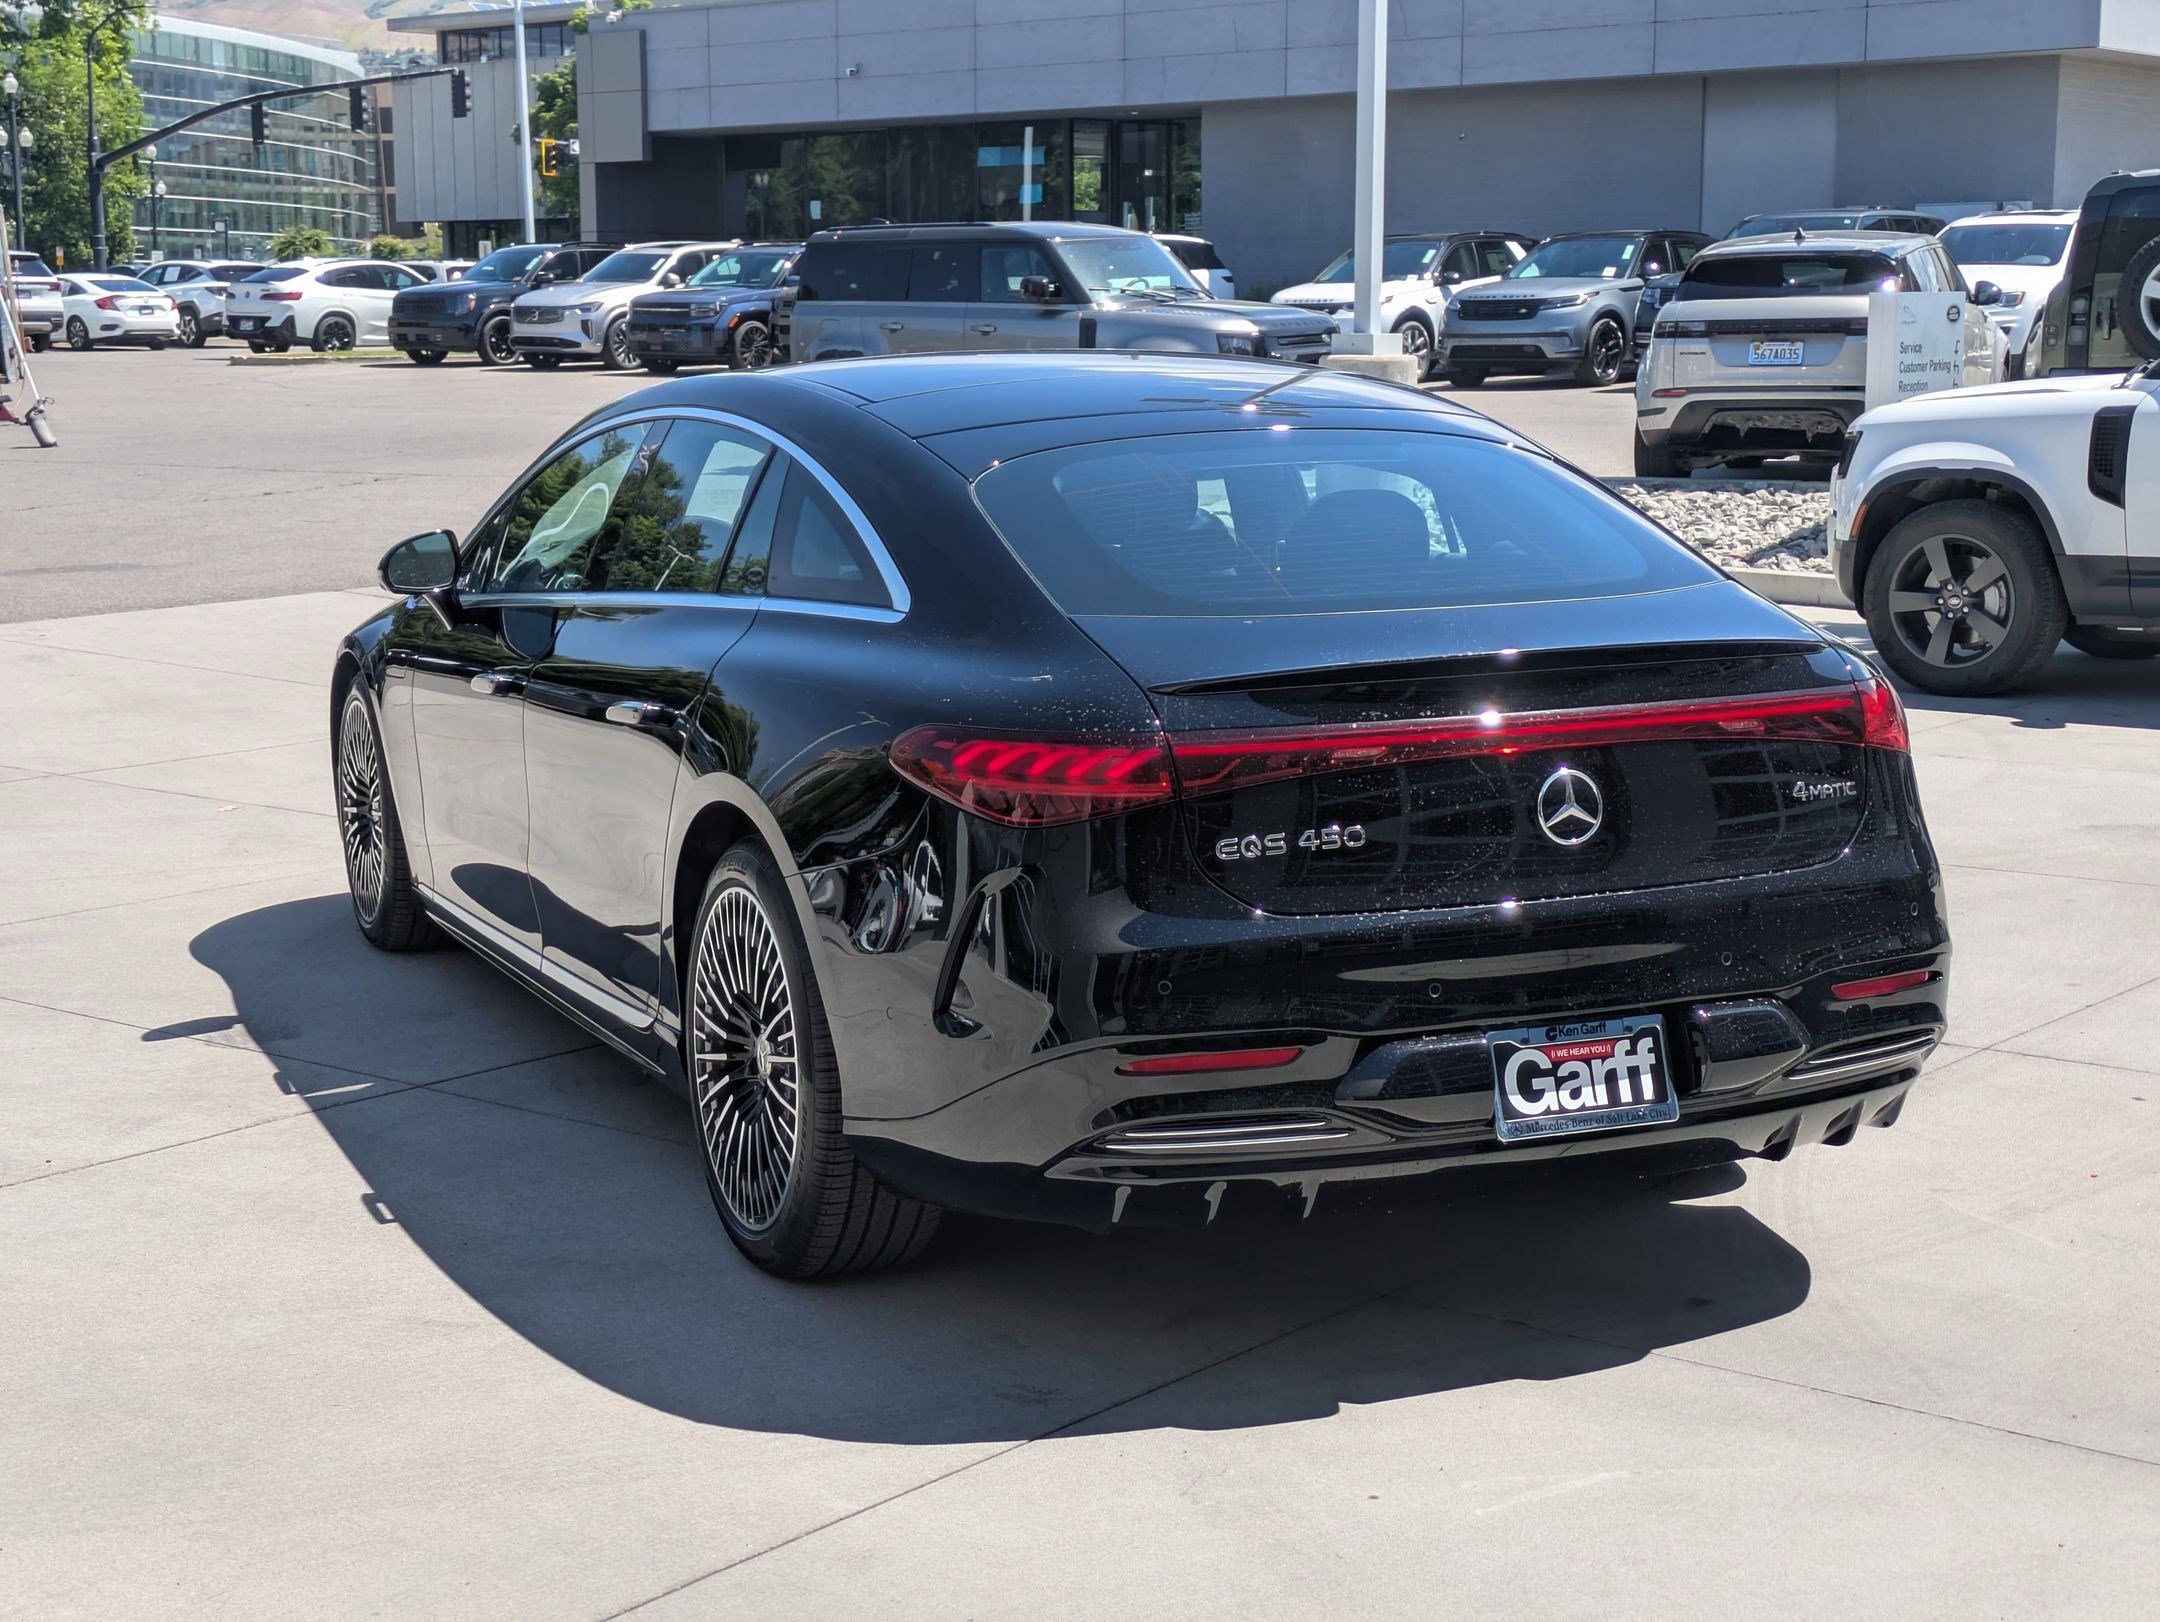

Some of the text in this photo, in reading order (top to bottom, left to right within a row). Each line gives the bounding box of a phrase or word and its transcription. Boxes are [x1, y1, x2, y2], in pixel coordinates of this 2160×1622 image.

[1899, 341, 1922, 354] Service
[1899, 359, 1952, 374] Customer Parking
[1898, 380, 1929, 395] Reception
[1215, 824, 1366, 860] EQS 450
[1558, 1021, 1607, 1037] Ken Garff
[1556, 1045, 1607, 1057] WE HEAR YOU
[1504, 1036, 1656, 1115] Garff
[1525, 1108, 1668, 1134] Mercedes-Benz of Salt Lake City
